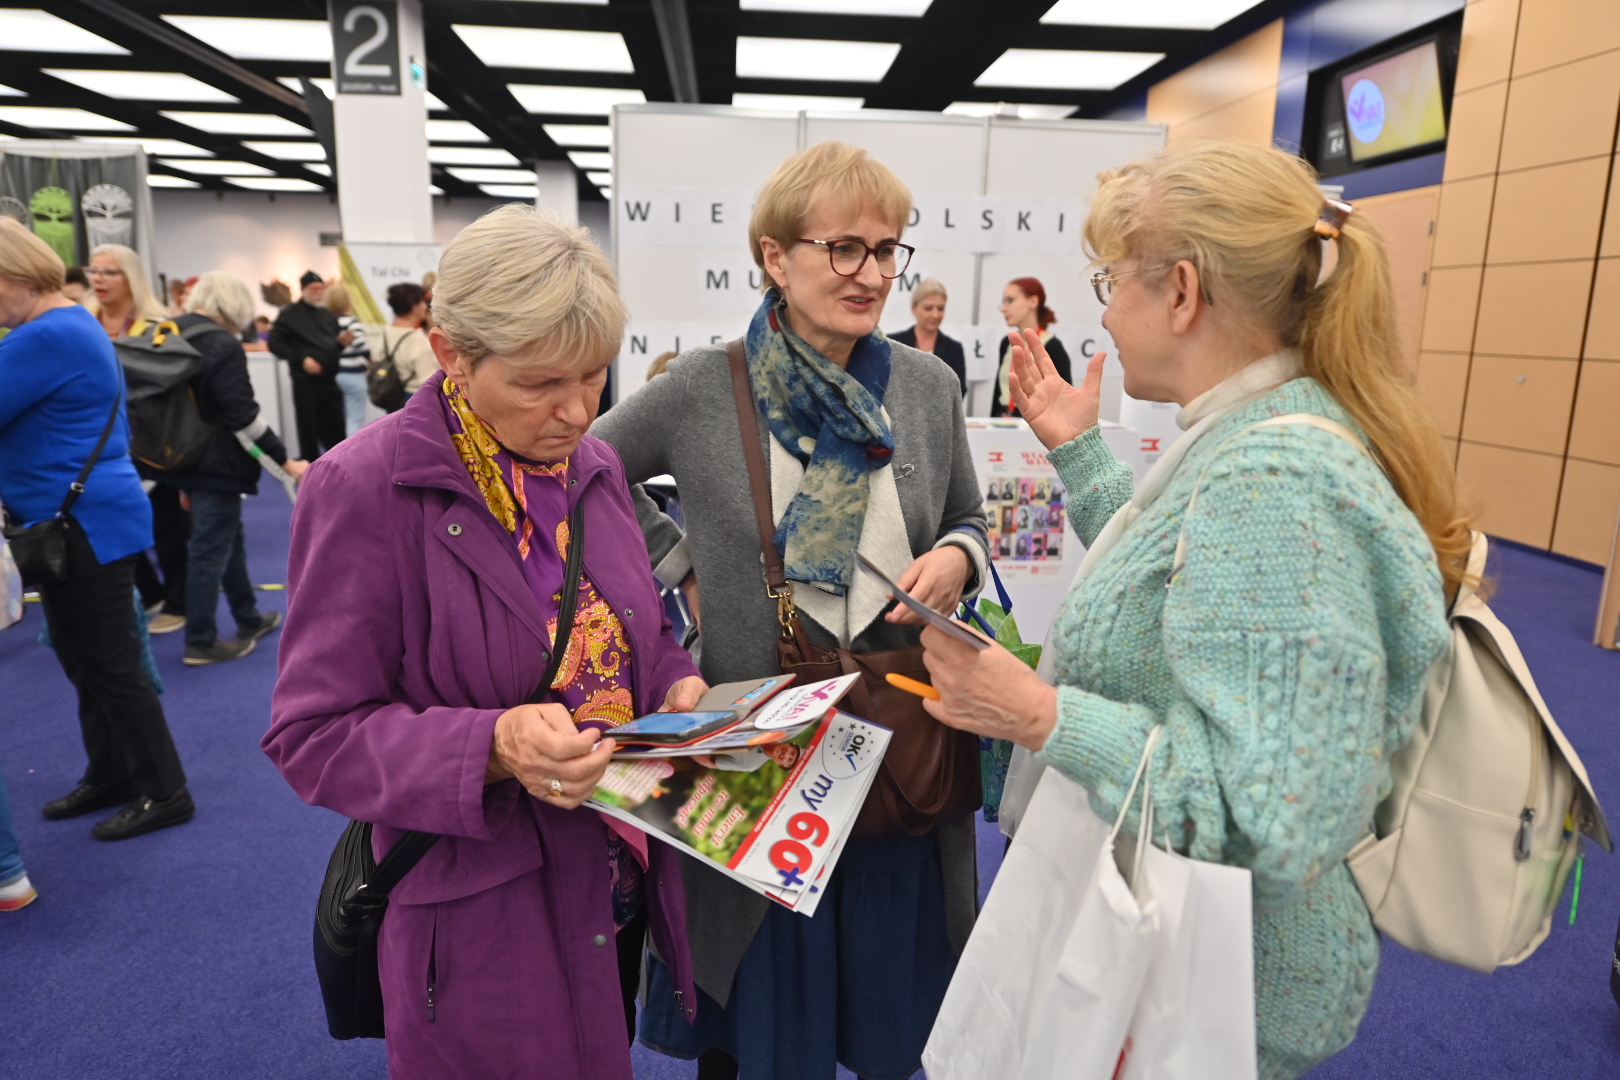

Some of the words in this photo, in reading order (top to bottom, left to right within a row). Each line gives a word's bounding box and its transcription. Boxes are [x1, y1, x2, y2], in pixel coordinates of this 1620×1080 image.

[343, 5, 392, 77] 2
[841, 731, 854, 752] SENIOR
[848, 734, 865, 756] OK
[675, 774, 716, 828] odpocząć!
[714, 791, 730, 809] też
[801, 774, 834, 811] my
[693, 809, 716, 838] musi
[711, 806, 746, 847] Emeryt
